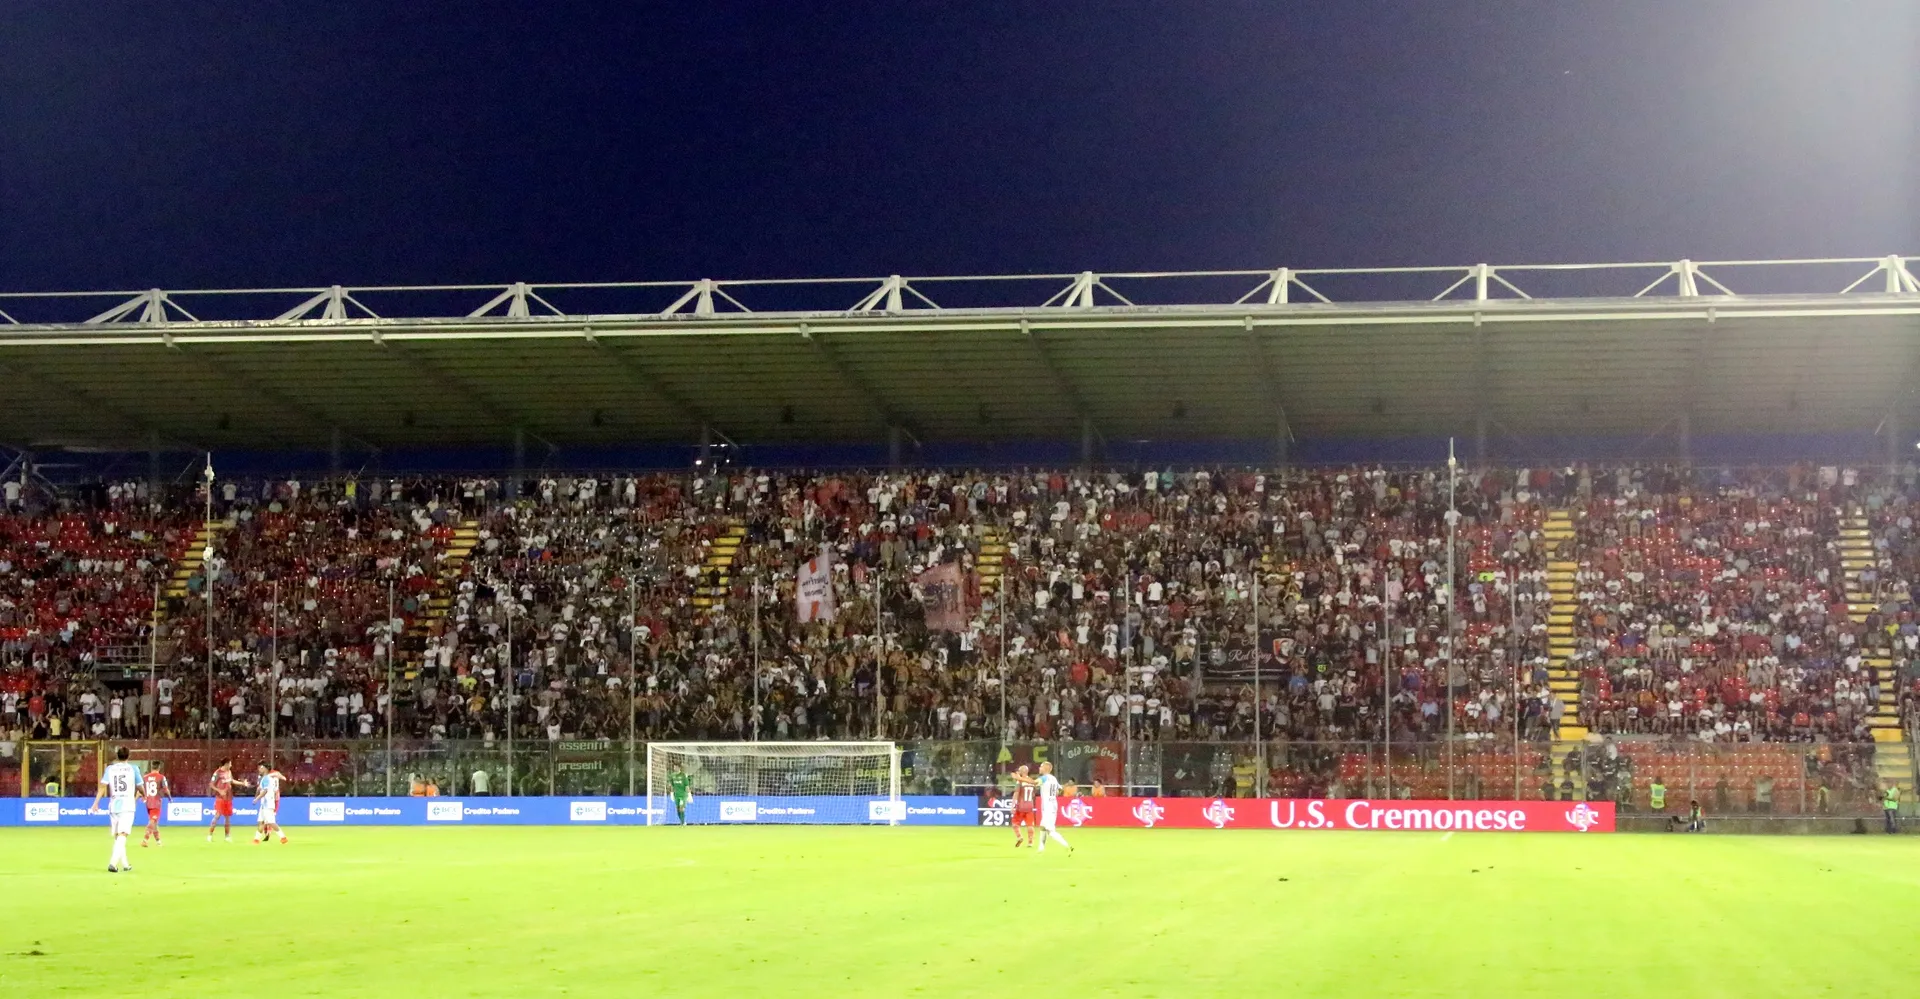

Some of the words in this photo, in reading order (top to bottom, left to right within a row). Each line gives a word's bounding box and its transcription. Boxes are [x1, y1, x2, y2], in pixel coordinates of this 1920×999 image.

[558, 761, 602, 771] presenti
[113, 775, 127, 792] 15
[146, 781, 158, 797] 18
[1024, 786, 1034, 801] 17
[345, 807, 373, 815] Credito
[374, 807, 401, 815] Padano
[463, 807, 491, 815] Credito
[492, 807, 520, 815] Padano
[607, 807, 635, 815] Credito
[758, 807, 786, 815] Credito
[787, 807, 815, 815] Padano
[907, 807, 936, 815] Credito
[937, 807, 966, 815] Padano
[1270, 800, 1333, 828] U.S.
[1345, 801, 1526, 829] Cremonese
